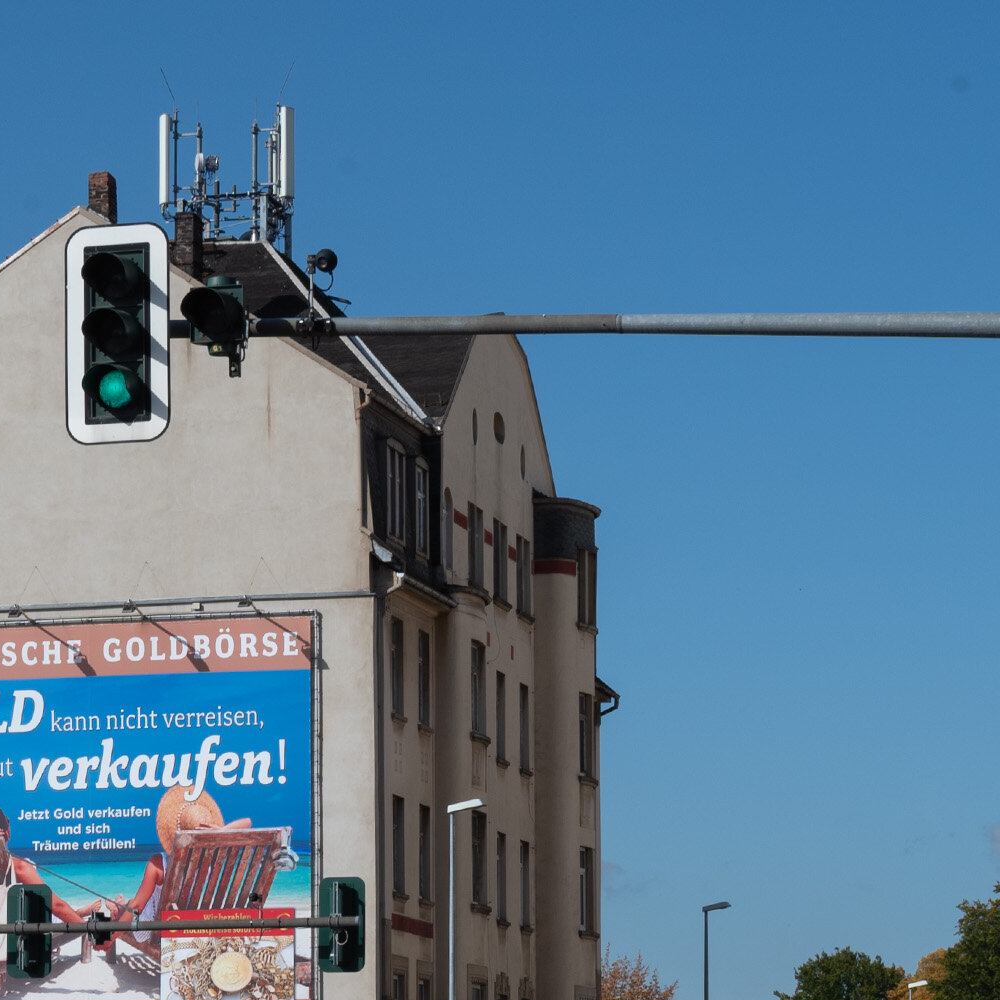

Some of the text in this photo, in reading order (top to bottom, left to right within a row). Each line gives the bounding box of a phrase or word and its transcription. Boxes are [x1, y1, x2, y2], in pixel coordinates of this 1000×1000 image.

[103, 628, 299, 662] GOLDBÖRSE
[50, 710, 100, 732] kann
[106, 706, 158, 730] nicht
[162, 705, 265, 730] verreisen,
[20, 734, 287, 802] verkaufen!
[18, 806, 151, 821] Jetzt Gold verkaufen
[57, 823, 110, 835] und sich
[32, 838, 136, 852] Träume erfüllen!
